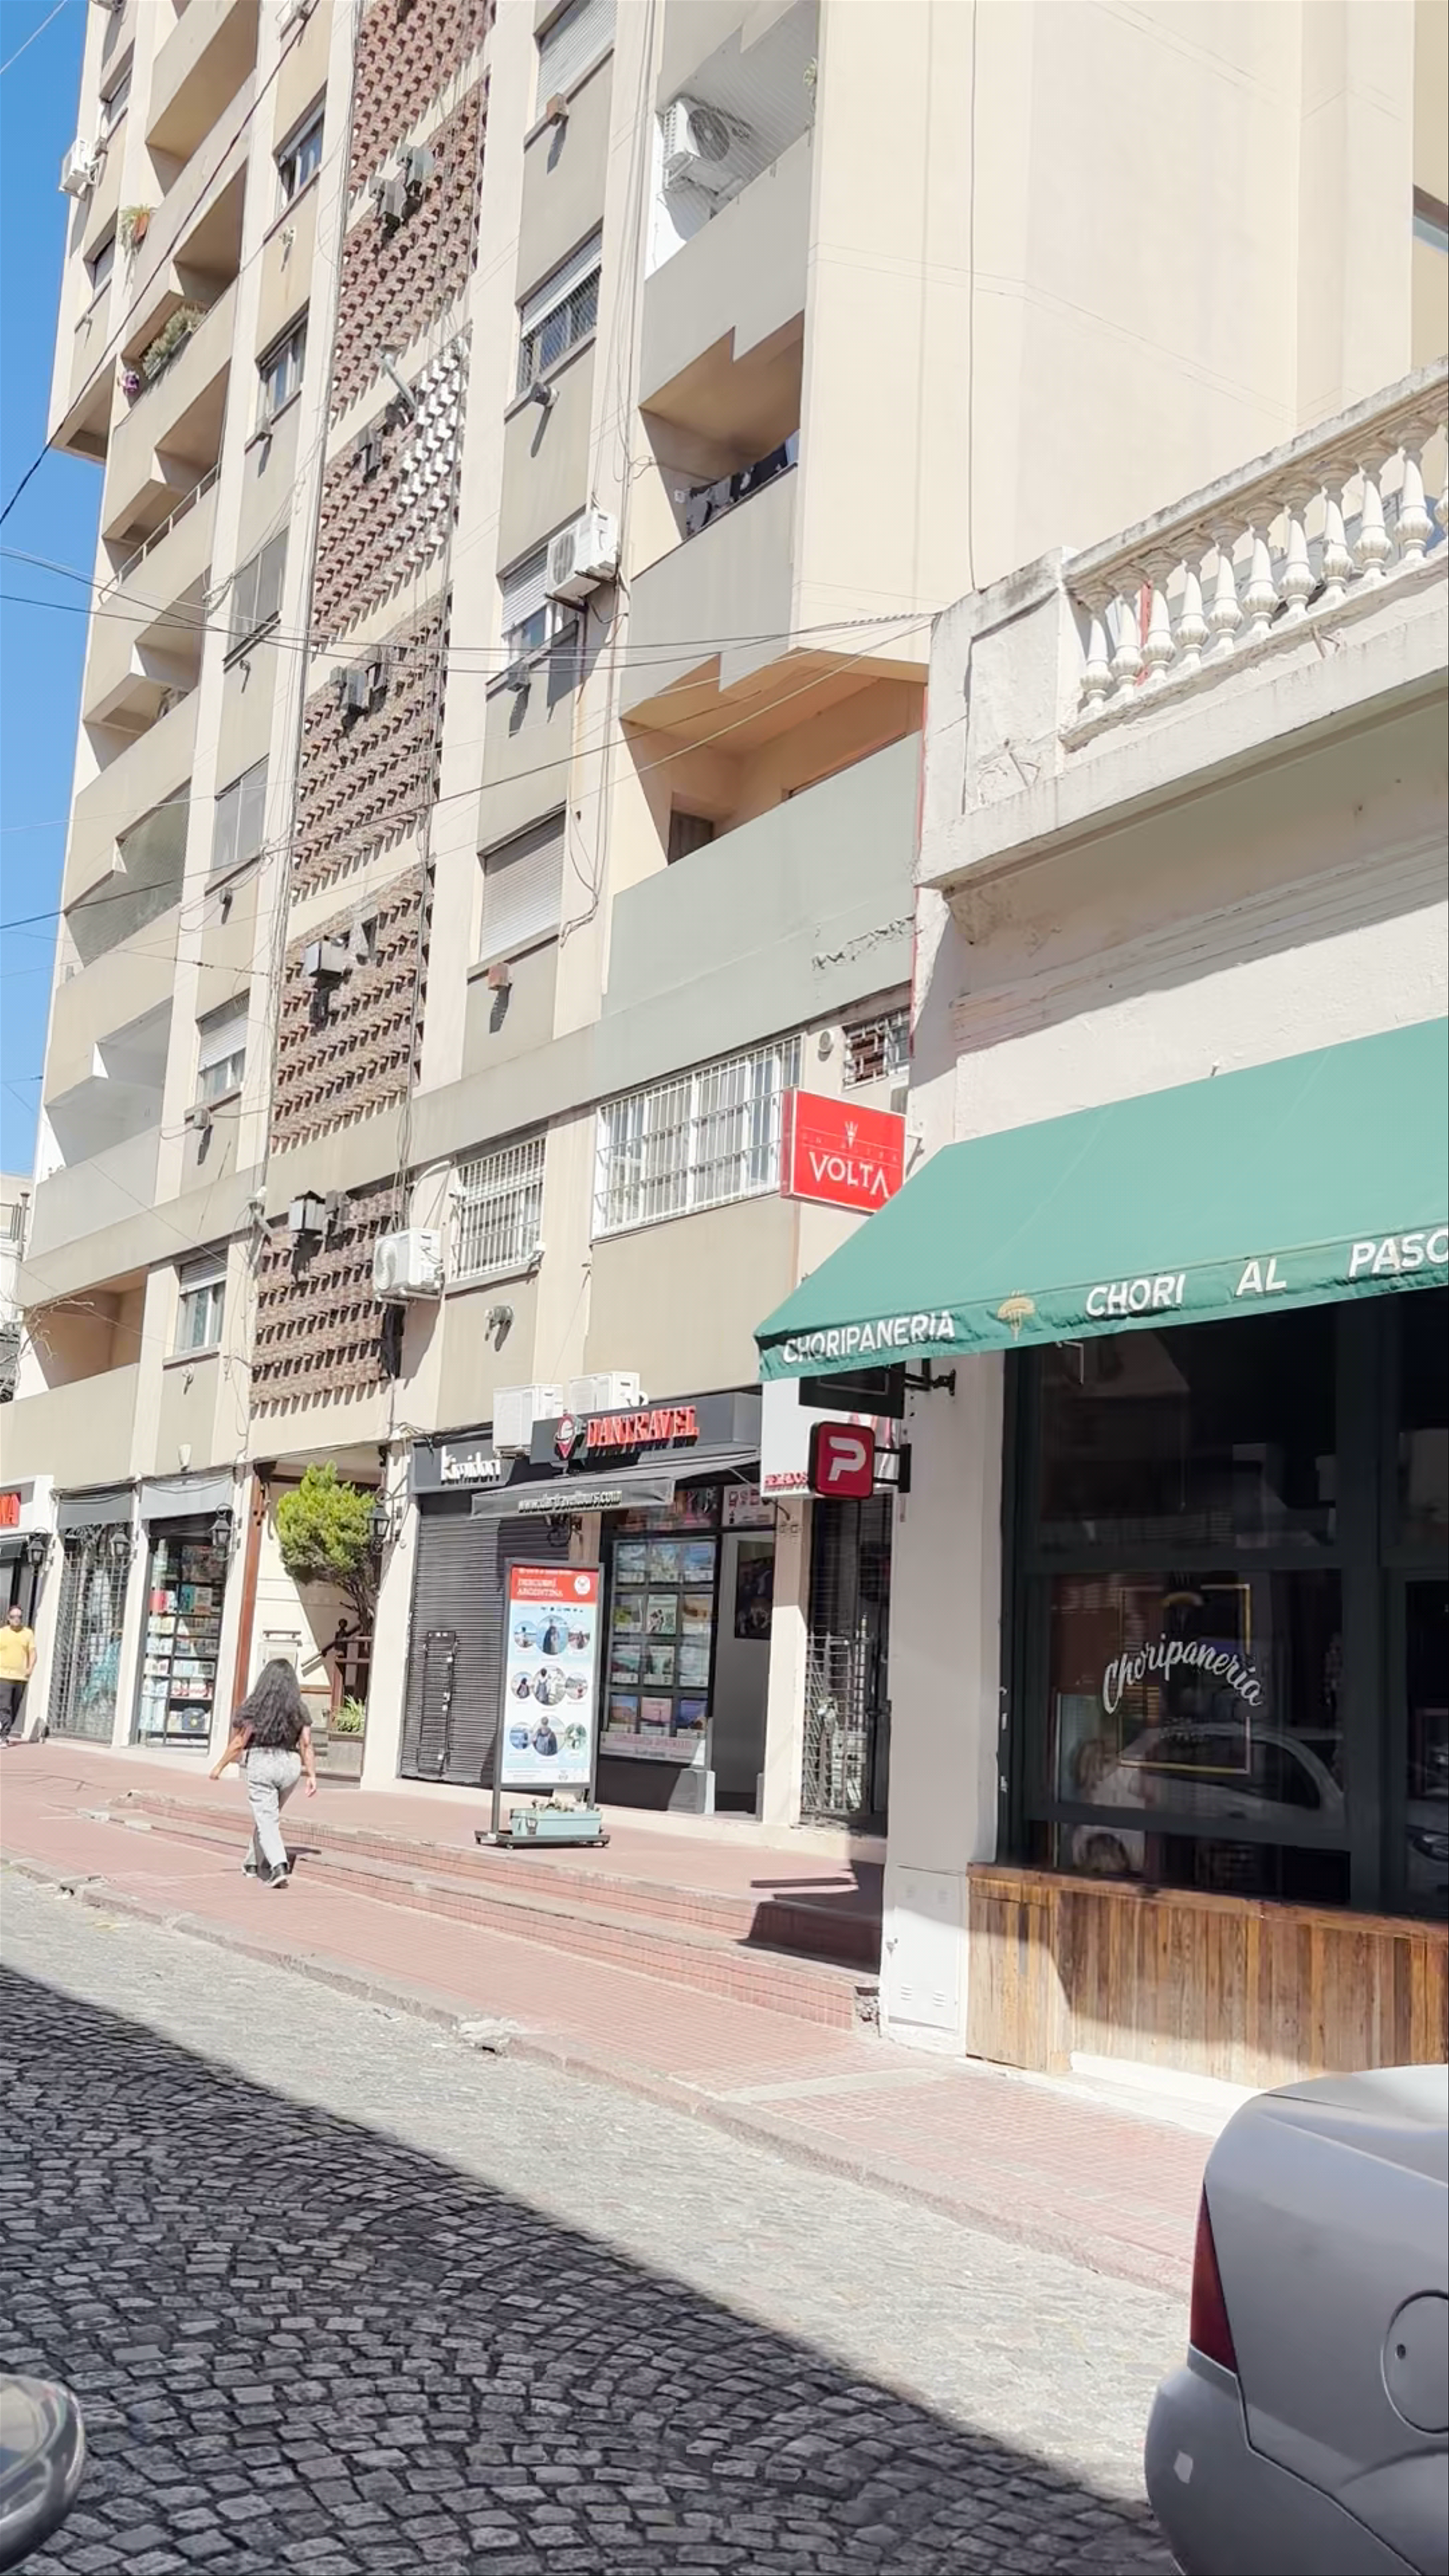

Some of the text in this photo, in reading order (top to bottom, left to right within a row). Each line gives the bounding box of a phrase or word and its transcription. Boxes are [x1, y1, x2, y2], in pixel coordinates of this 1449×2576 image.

[809, 1152, 890, 1199] VOLTA
[1086, 1228, 1449, 1316] CHORI AL PASO
[783, 1310, 955, 1364] CHORIPANERIA
[586, 1405, 700, 1447] DANTRAVEL
[828, 1436, 867, 1481] P
